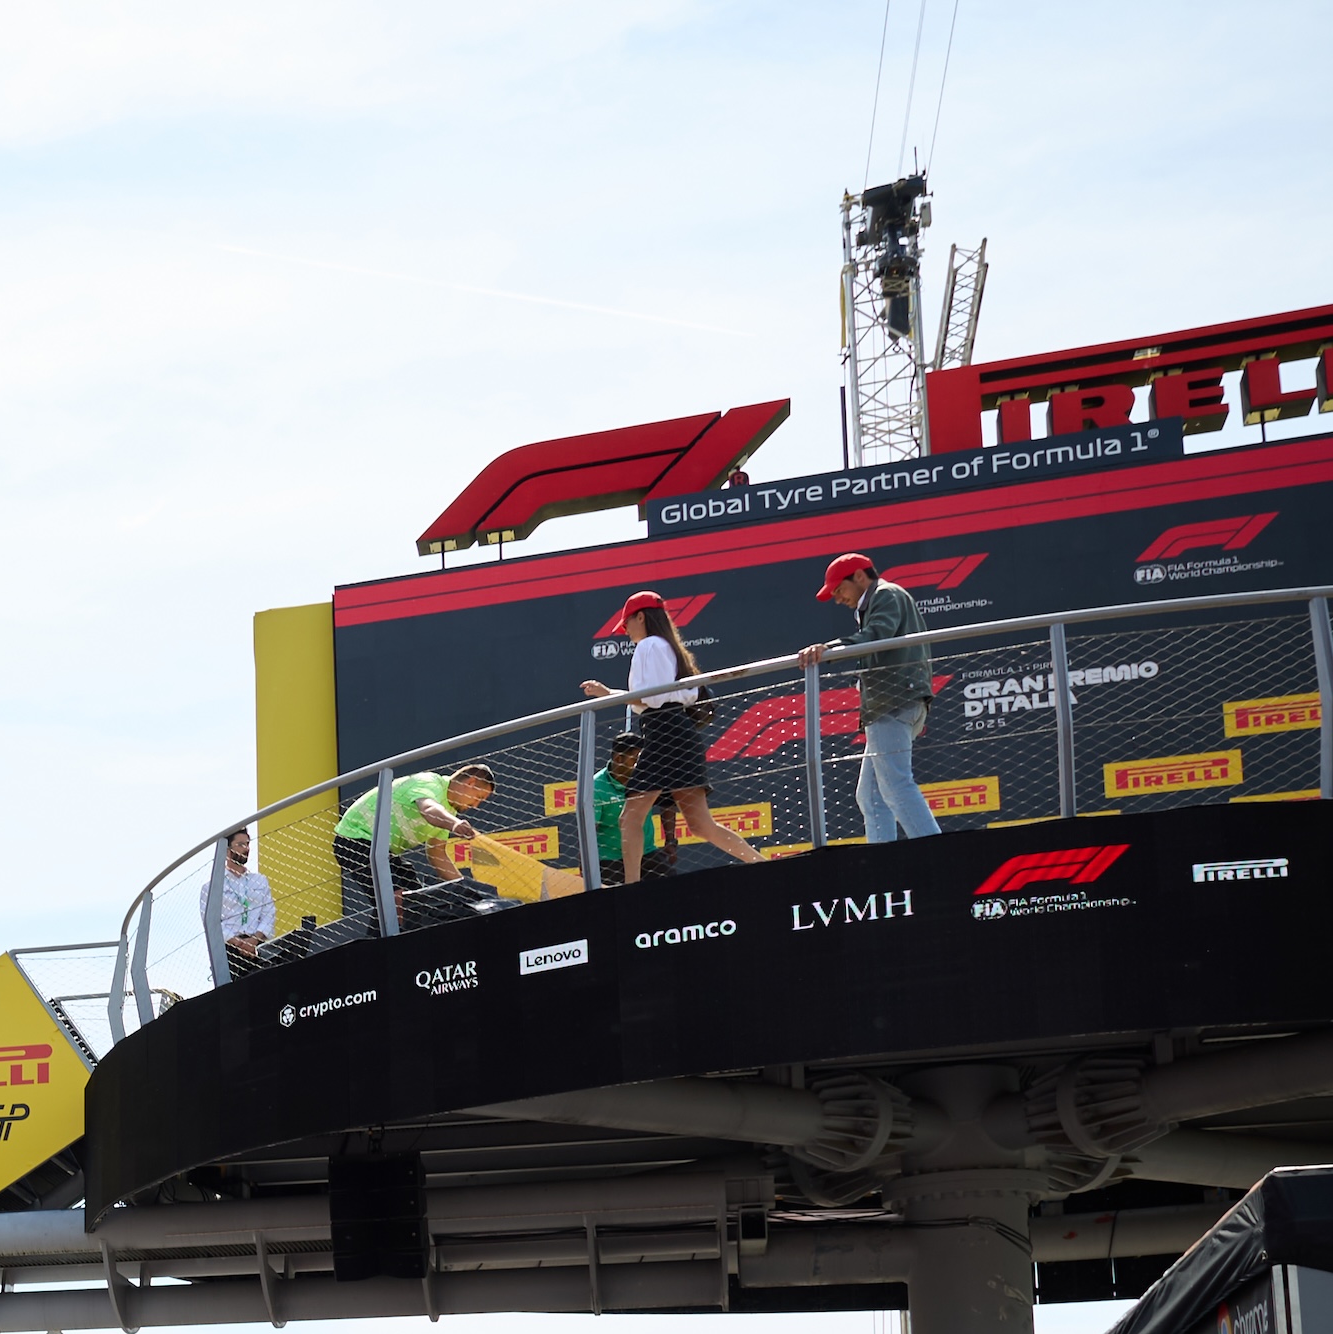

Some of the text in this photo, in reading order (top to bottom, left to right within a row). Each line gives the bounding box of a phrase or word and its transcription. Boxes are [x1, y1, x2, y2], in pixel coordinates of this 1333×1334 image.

[659, 436, 1121, 526] Global Tyre Partner of Formula
[1168, 556, 1239, 572] FIA Formula 1
[1169, 558, 1279, 581] World Championship
[963, 674, 1044, 699] GRAN
[965, 718, 1006, 731] 2025
[1115, 757, 1230, 790] PIRELLI
[1192, 857, 1289, 883] PIRELLI
[790, 889, 915, 931] LVMH
[1029, 893, 1079, 906] Formula
[635, 918, 737, 949] aramco
[525, 945, 582, 968] Lenovo
[415, 960, 478, 989] QATAR
[431, 976, 479, 996] AIRWAYS
[299, 988, 377, 1020] crypto.com
